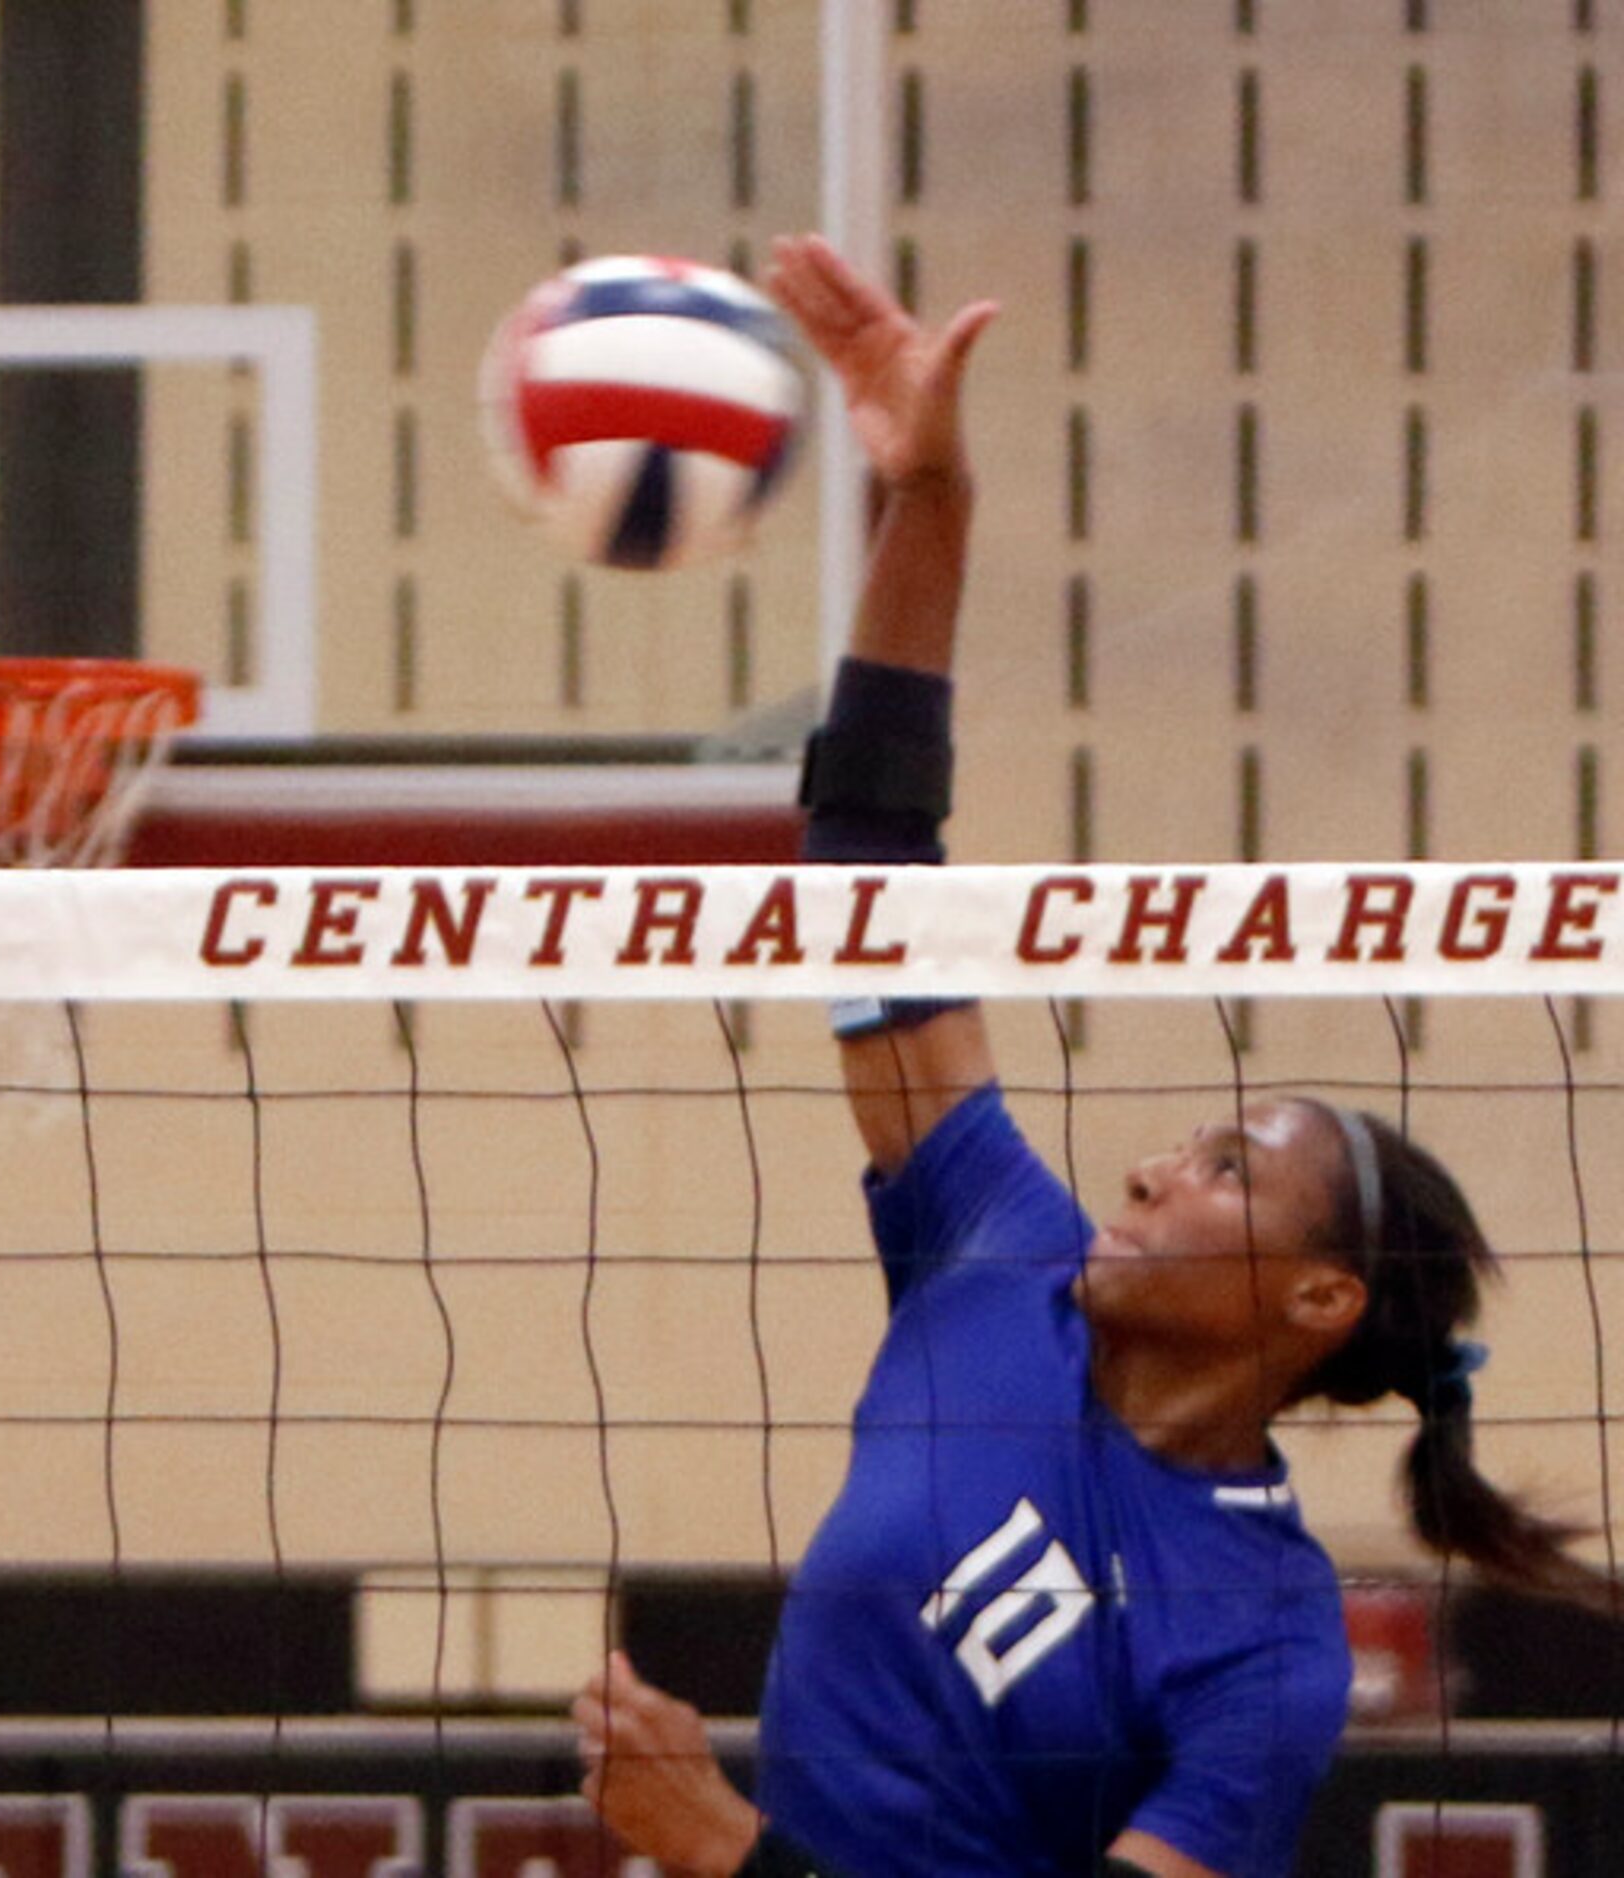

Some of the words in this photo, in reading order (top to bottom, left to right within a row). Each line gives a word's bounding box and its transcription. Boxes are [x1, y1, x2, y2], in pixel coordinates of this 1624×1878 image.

[199, 878, 907, 967] CENTRAL
[1015, 874, 1621, 964] CHARGE
[919, 1496, 1096, 1708] 10
